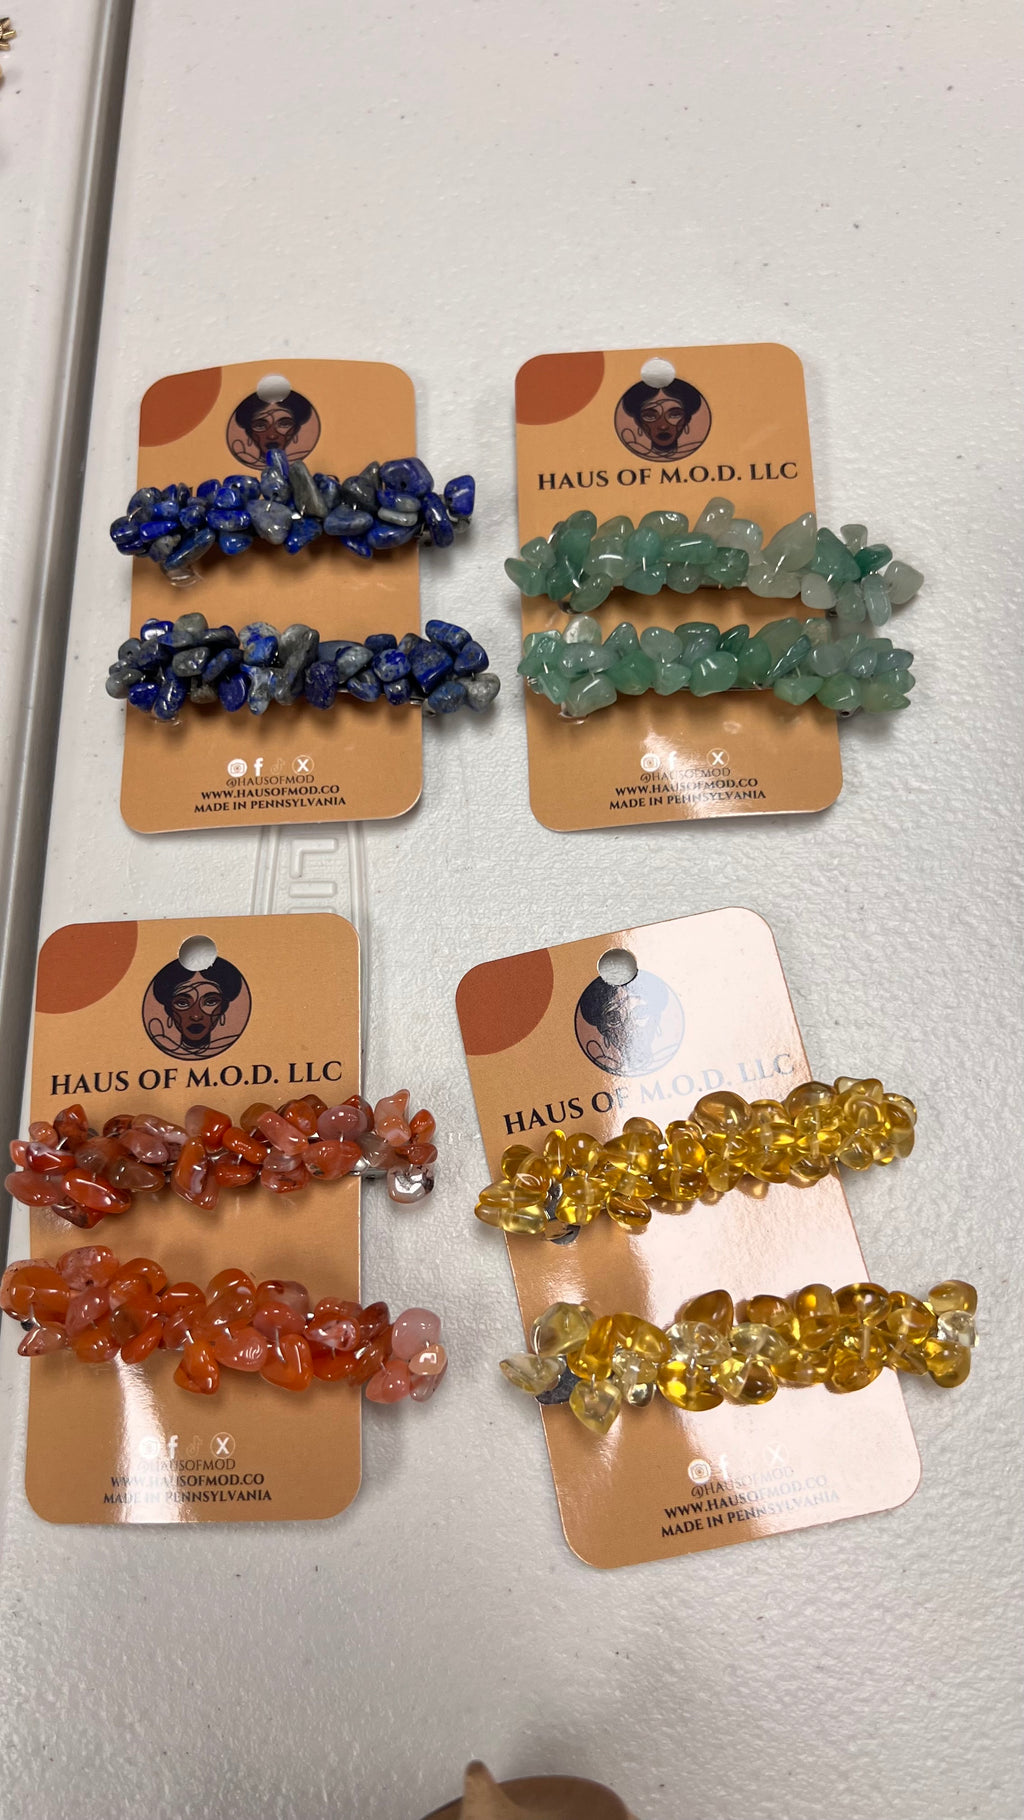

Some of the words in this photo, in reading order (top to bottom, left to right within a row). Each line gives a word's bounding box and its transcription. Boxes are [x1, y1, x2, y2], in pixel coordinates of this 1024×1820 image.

[538, 470, 609, 490] HAUS
[617, 468, 651, 486] OF
[660, 464, 742, 484] M.O.D.
[750, 462, 798, 480] LLC
[226, 774, 315, 788] @HAUSOFMOD
[640, 767, 731, 783] @HAUSOFMOD
[201, 784, 340, 800] WWW.HAUSOFMOD.CO
[615, 778, 758, 796] WWW.HAUSOFMOD.CO
[194, 801, 230, 813] MADE
[233, 801, 247, 811] IN
[250, 797, 346, 810] PENNSYLVANIA
[609, 798, 646, 810] MADE
[649, 796, 663, 806] IN
[667, 790, 766, 805] PENNSYLVANIA
[50, 1071, 129, 1096] HAUS
[138, 1068, 178, 1090] OF
[187, 1064, 279, 1088] M.O.D.
[288, 1060, 342, 1083] LLC
[503, 1097, 584, 1135] HAUS
[591, 1087, 629, 1113] OF
[640, 1068, 733, 1103] M.O.D.
[738, 1053, 795, 1083] LLC
[691, 1466, 794, 1499] @HAUSOFMOD
[167, 1490, 272, 1503] PENNSYLVANIA
[664, 1475, 827, 1520] WWW.HAUSOFMOD.CO
[661, 1518, 704, 1538] MADE
[706, 1514, 724, 1529] IN
[727, 1488, 840, 1524] PENNSYLVANIA
